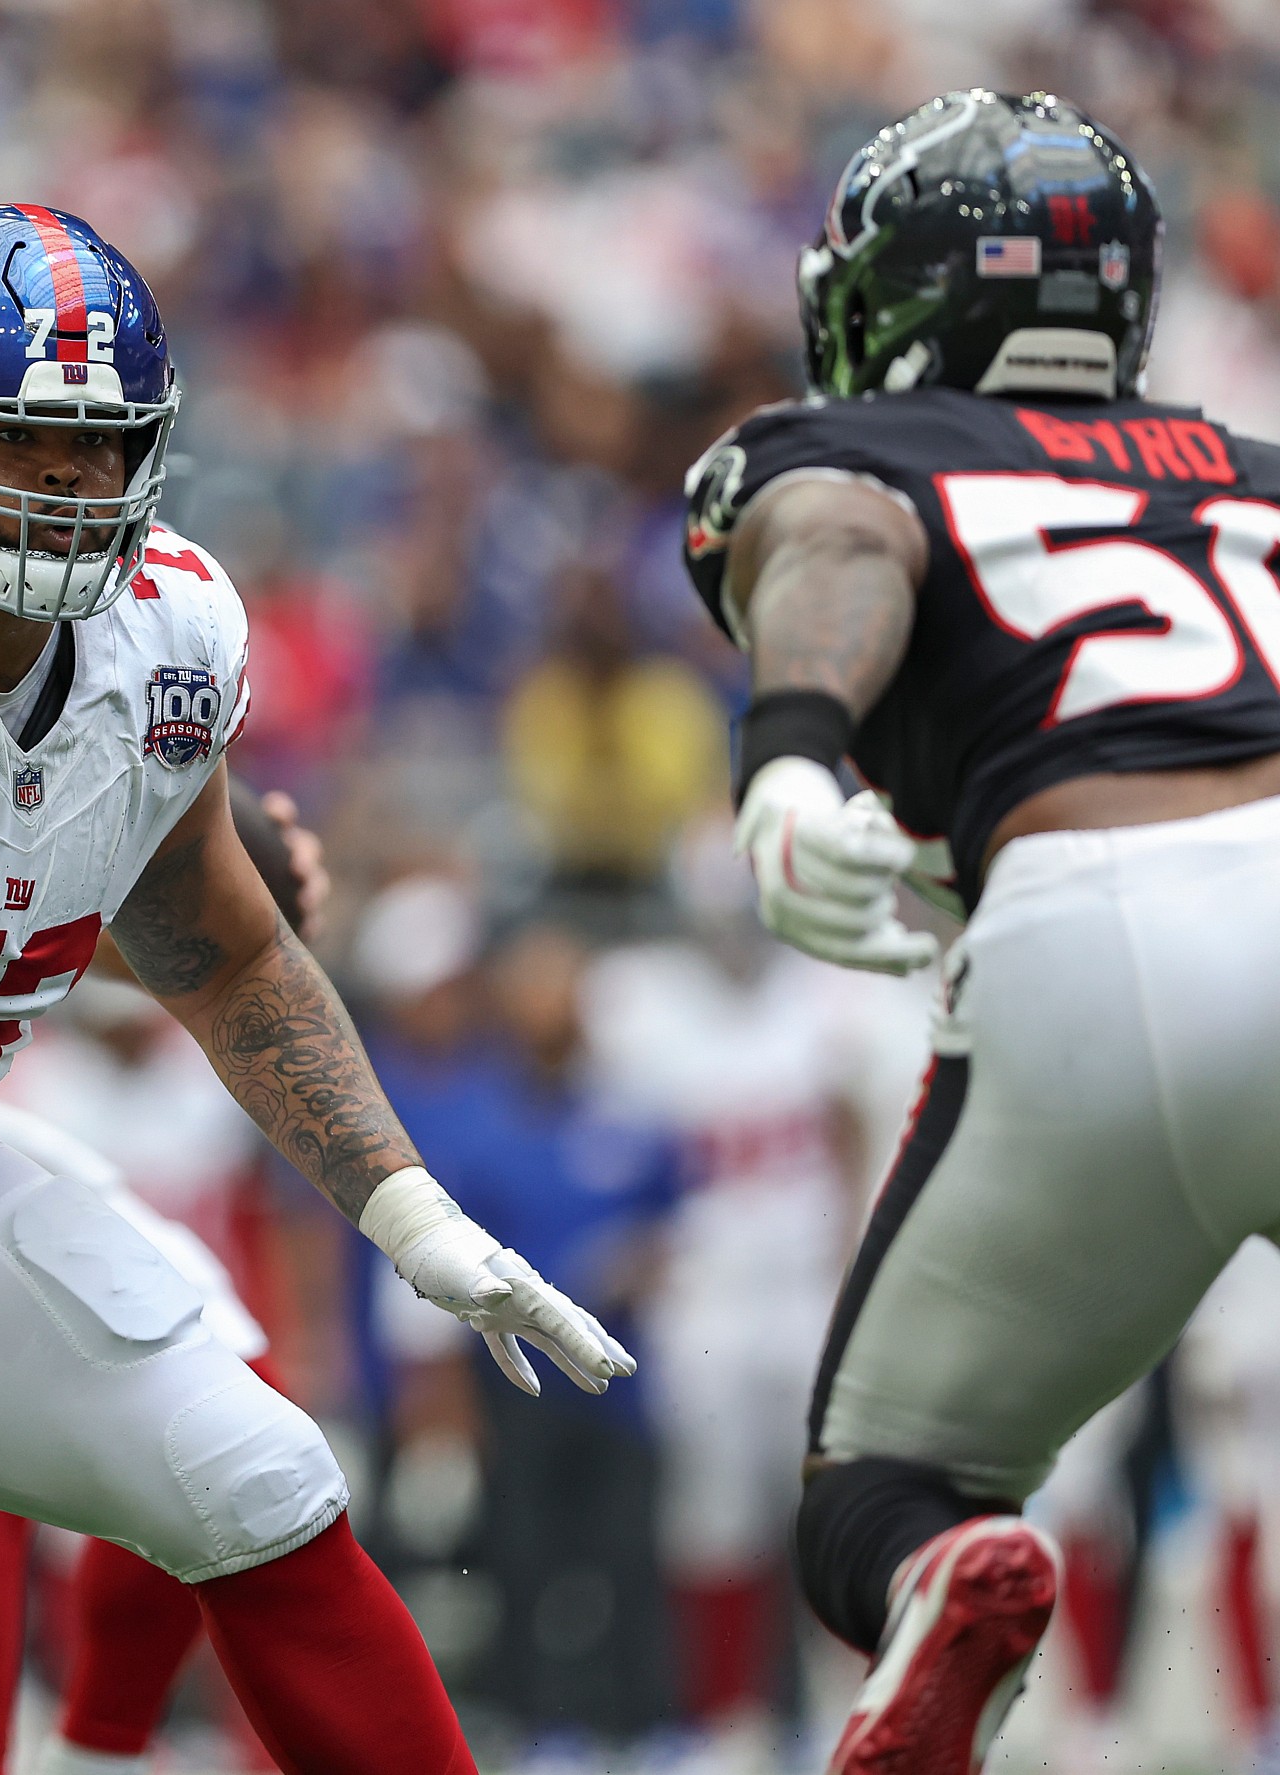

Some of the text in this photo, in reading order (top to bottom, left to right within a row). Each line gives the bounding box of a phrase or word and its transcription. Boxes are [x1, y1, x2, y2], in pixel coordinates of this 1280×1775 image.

[1015, 405, 1237, 485] BYRD
[150, 685, 219, 727] 100
[154, 724, 208, 740] SEASONS
[17, 784, 41, 803] NFL
